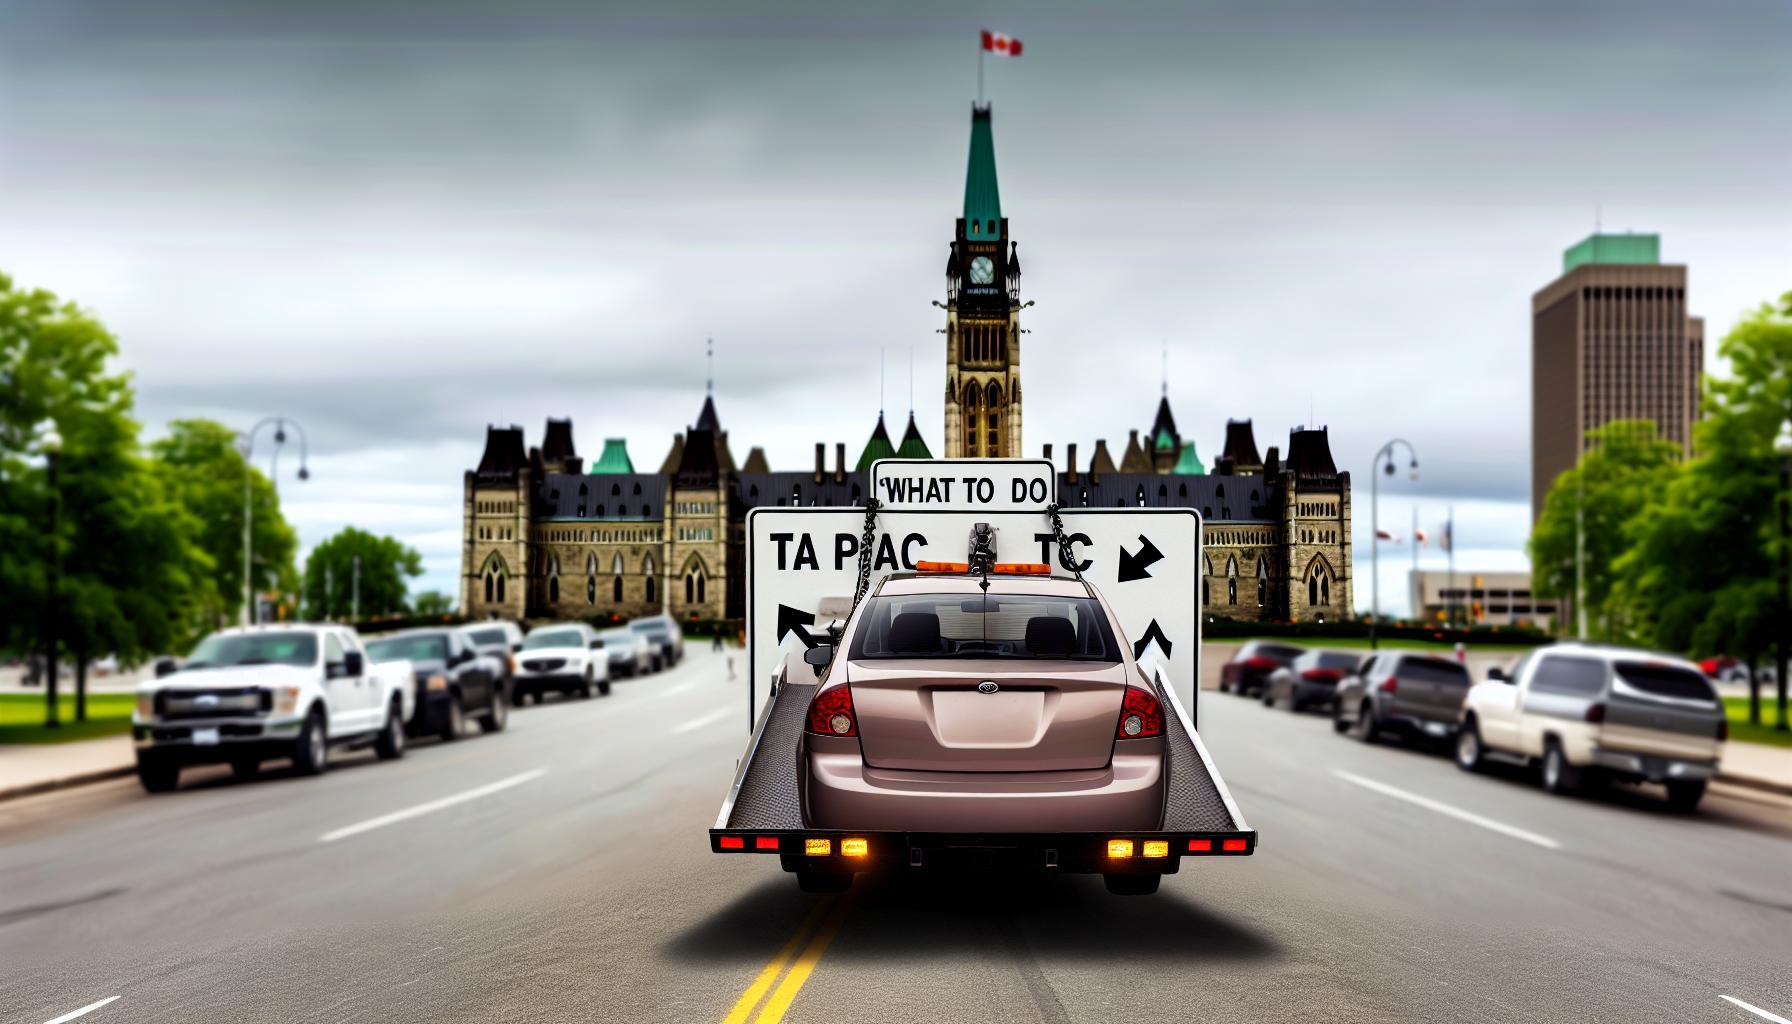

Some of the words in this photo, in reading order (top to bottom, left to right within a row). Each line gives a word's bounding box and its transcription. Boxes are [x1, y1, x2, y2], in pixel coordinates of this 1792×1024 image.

[962, 477, 995, 503] TO
[1011, 477, 1048, 503] DO
[769, 532, 820, 570] TA
[1034, 532, 1094, 572] TC
